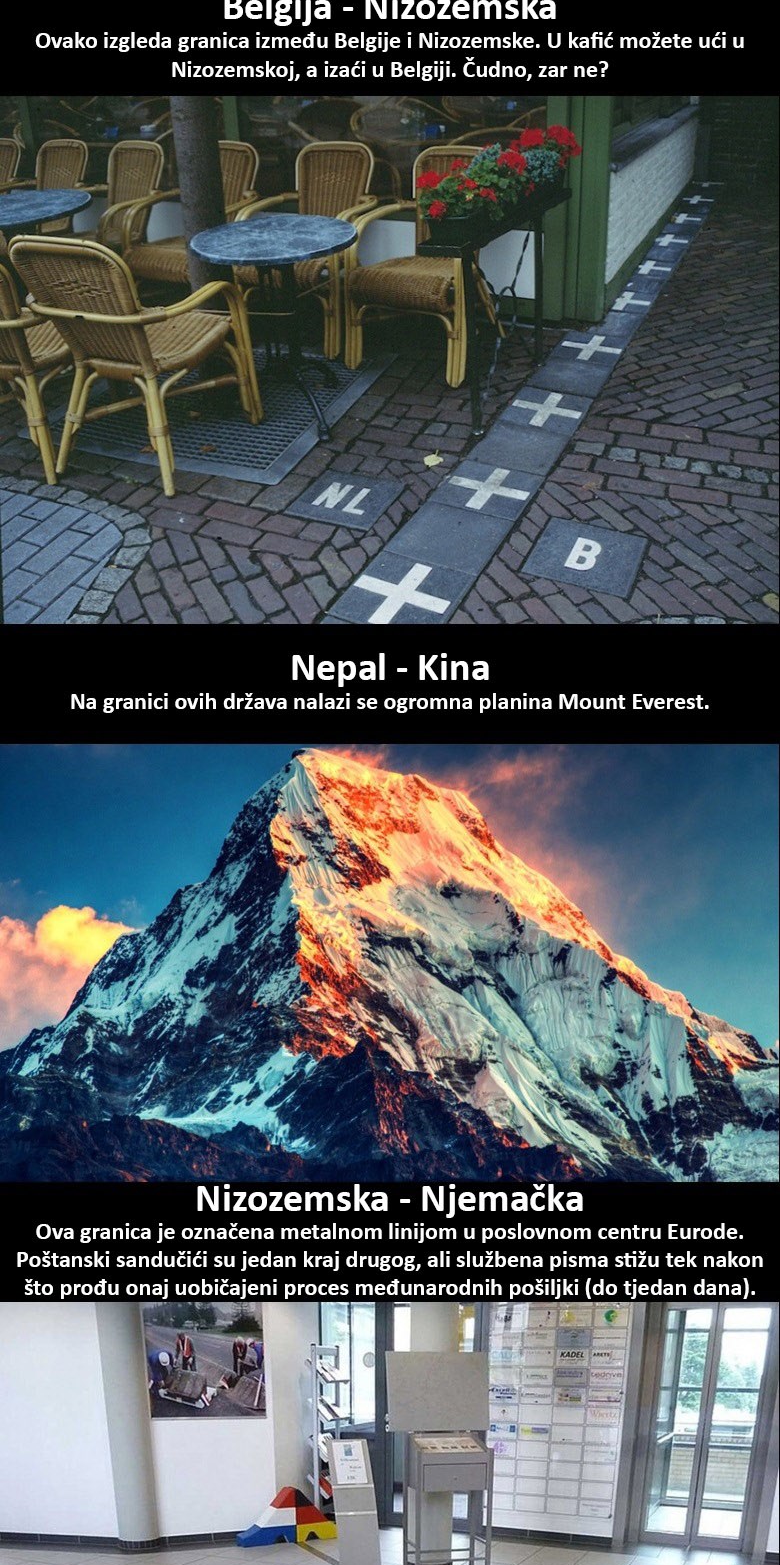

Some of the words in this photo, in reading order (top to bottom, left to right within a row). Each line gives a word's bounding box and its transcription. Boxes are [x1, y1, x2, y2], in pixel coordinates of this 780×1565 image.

[312, 482, 372, 516] NL
[563, 537, 602, 572] B
[559, 1351, 585, 1359] KADEL
